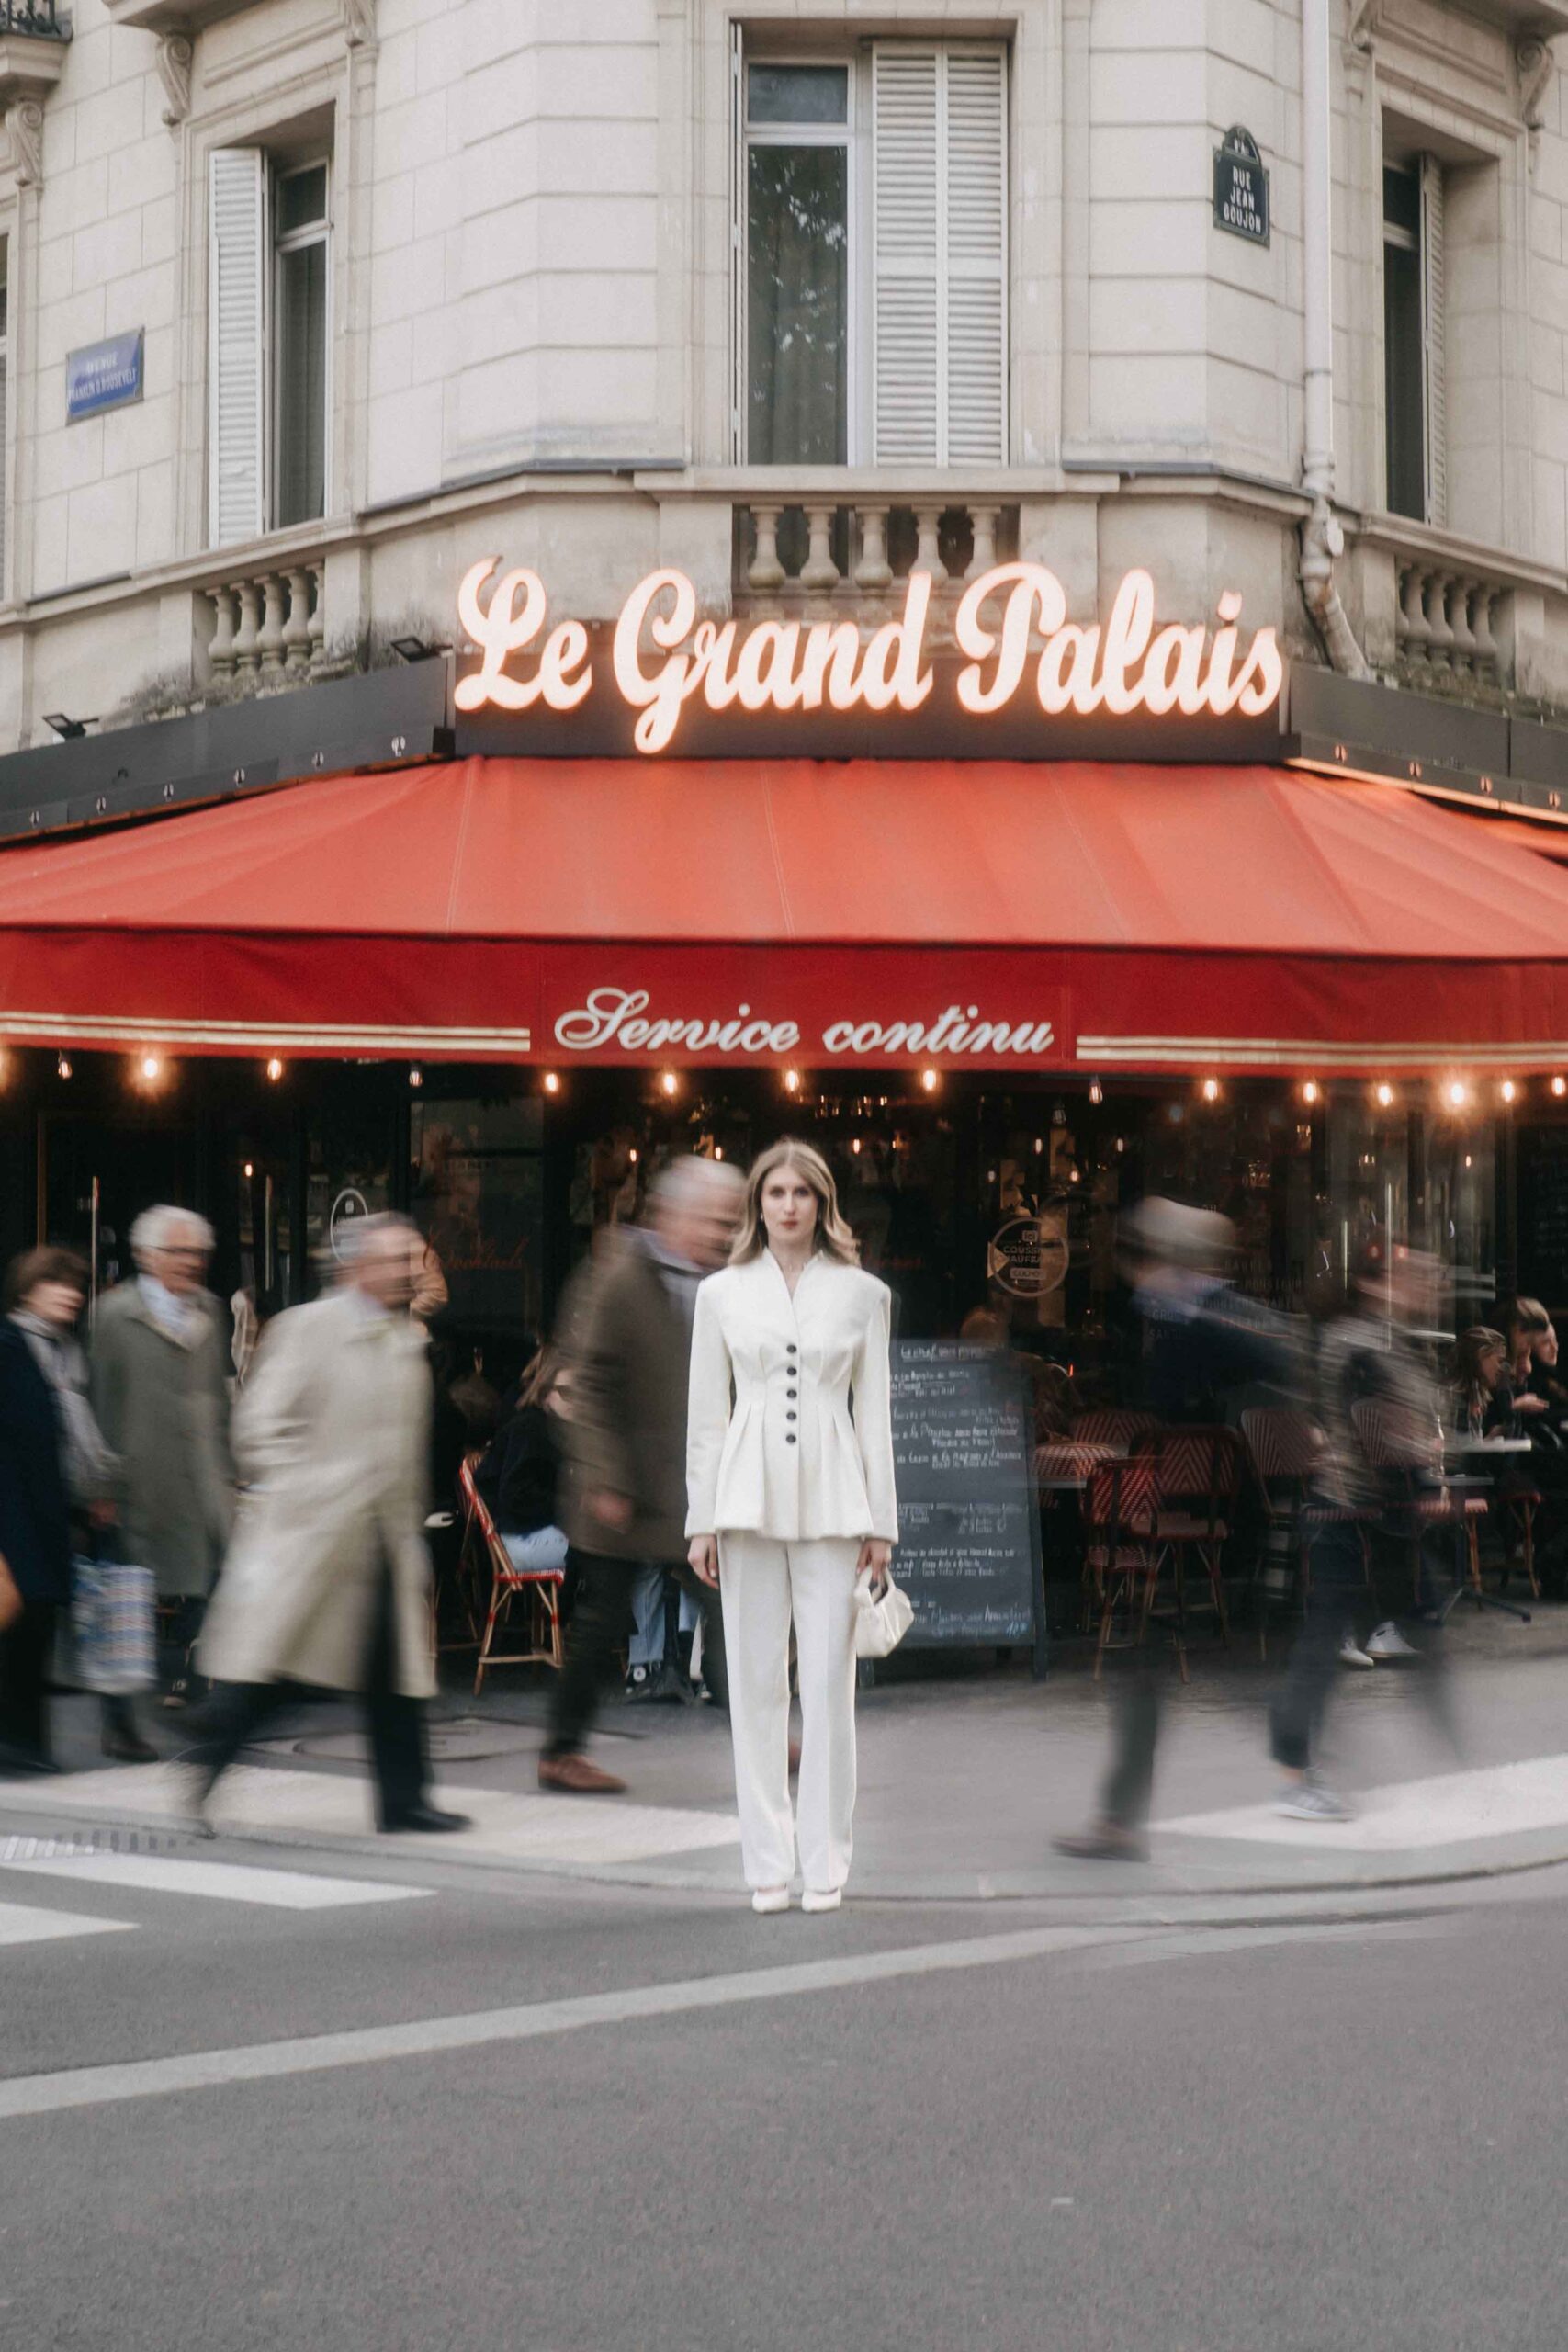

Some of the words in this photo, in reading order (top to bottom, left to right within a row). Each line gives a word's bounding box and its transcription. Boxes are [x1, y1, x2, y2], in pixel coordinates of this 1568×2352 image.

[1233, 165, 1252, 191] RUE
[1230, 187, 1255, 212] JEAN
[1223, 201, 1262, 234] GOUJON
[454, 556, 591, 710] Le
[613, 567, 934, 754] Grand
[955, 560, 1283, 716] Palais
[554, 986, 800, 1052] Service
[822, 1004, 1055, 1054] continu
